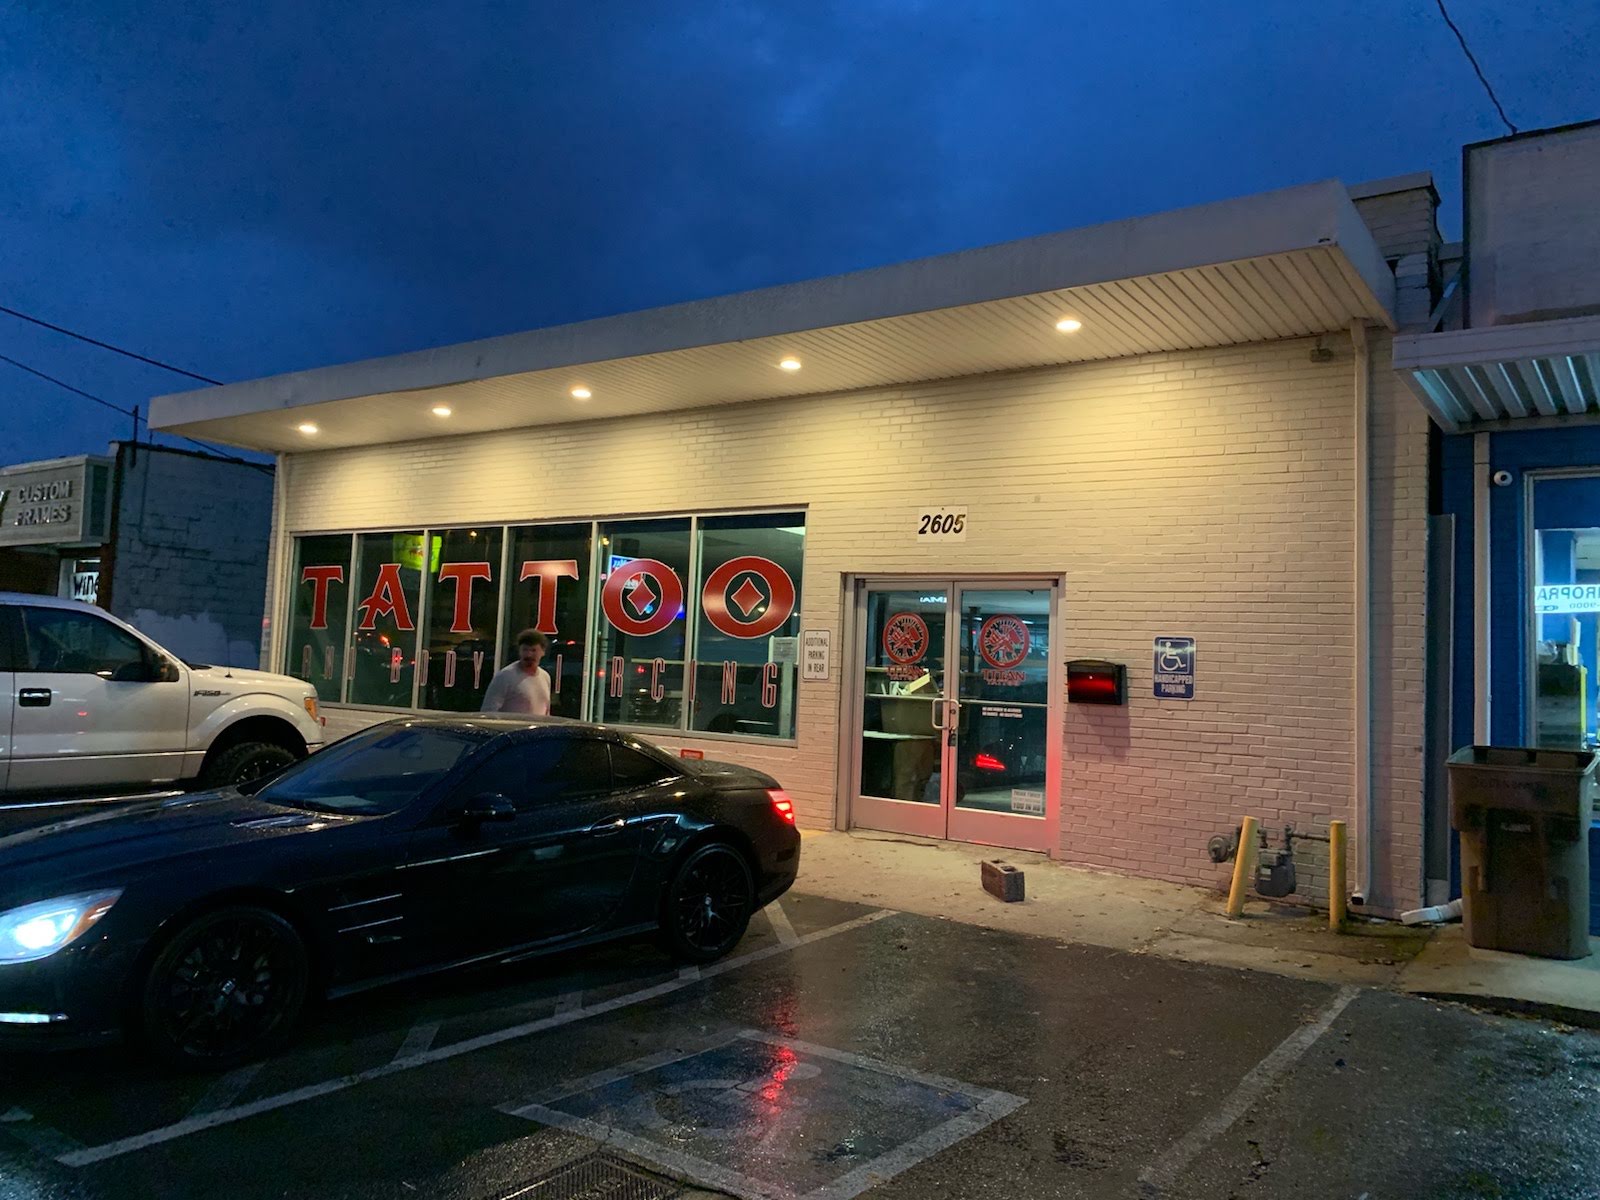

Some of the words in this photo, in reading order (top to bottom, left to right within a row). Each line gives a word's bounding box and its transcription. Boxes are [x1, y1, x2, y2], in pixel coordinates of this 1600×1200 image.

[18, 480, 72, 503] CUSTOM
[14, 505, 71, 526] FRAMES
[918, 514, 966, 534] 2605
[301, 556, 796, 639] TATTOO
[806, 637, 828, 647] ADDITIONAL
[808, 651, 825, 660] PARKING
[390, 647, 484, 689] BODY
[813, 663, 825, 673] REAR
[1154, 673, 1193, 684] HANDICAPPED
[1161, 683, 1186, 694] PARKING
